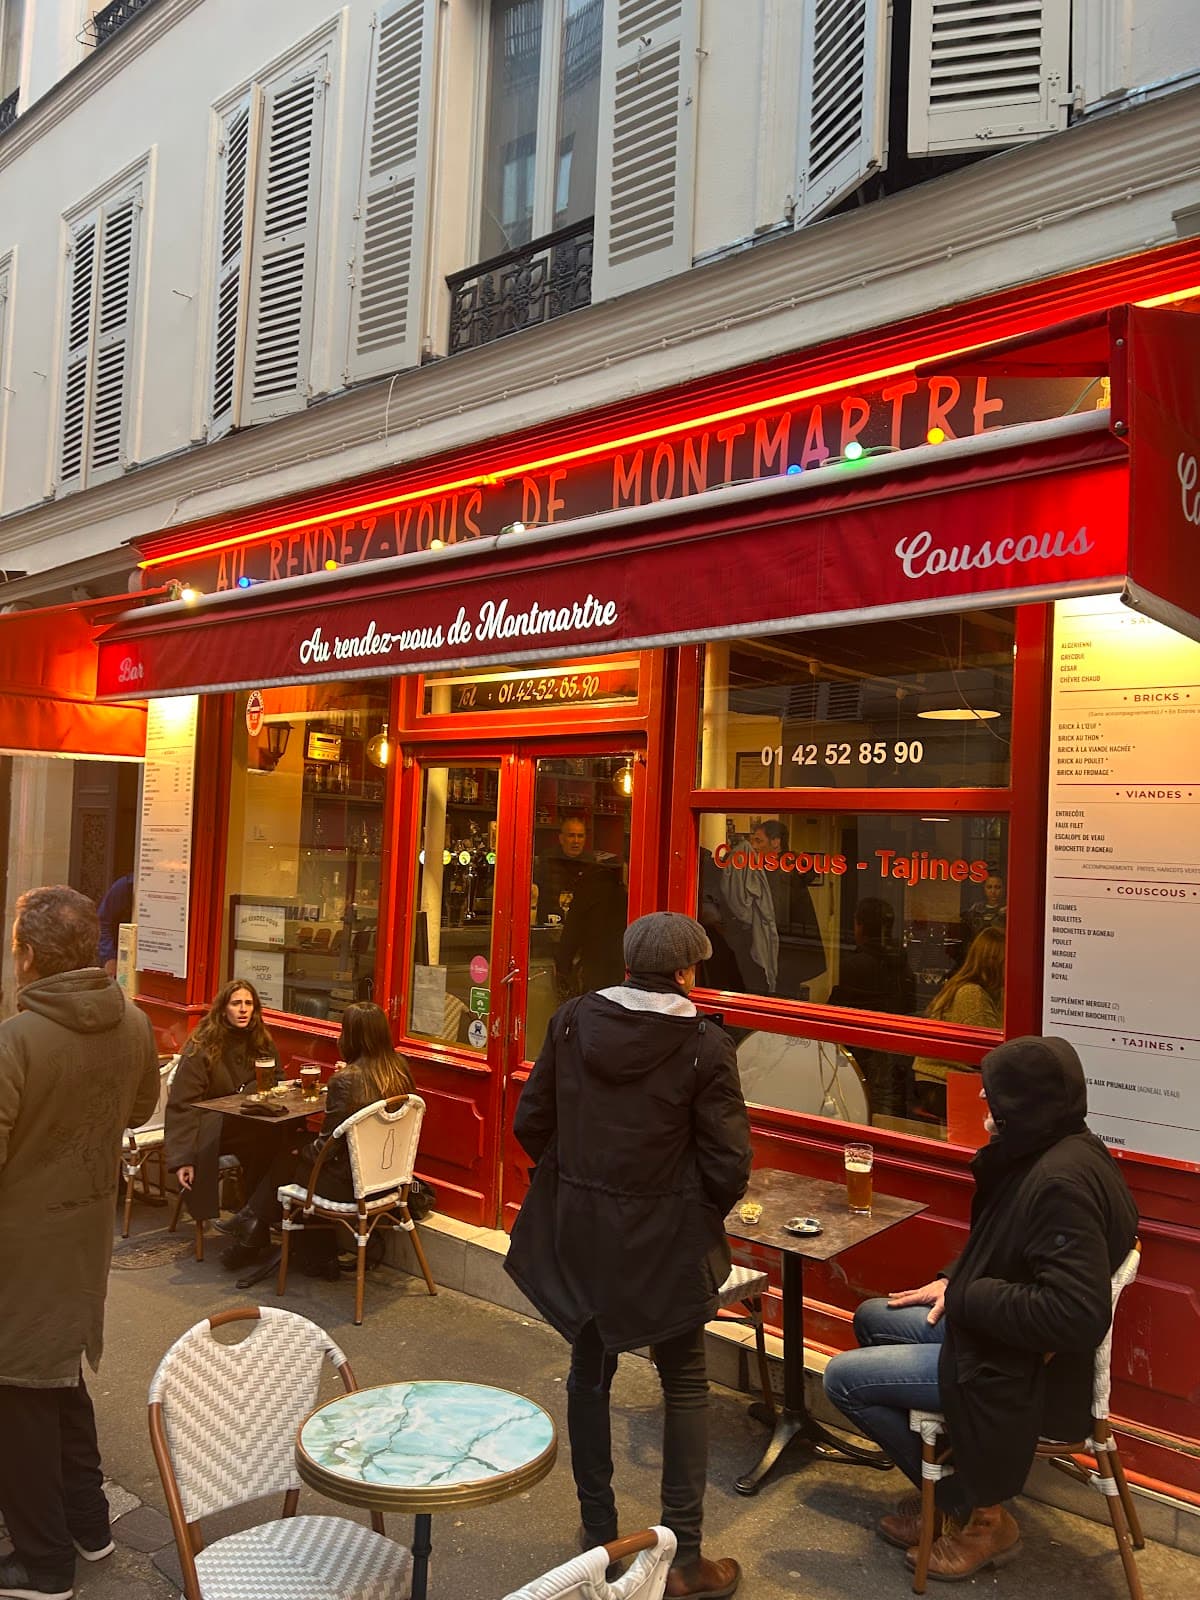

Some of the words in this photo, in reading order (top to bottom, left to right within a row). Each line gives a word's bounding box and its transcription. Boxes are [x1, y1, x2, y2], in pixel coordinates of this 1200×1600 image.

[216, 547, 248, 592] AU
[269, 491, 483, 582] RENDEZ-VOUS
[521, 469, 567, 529] DE
[611, 375, 1004, 509] MONTMARTRE
[895, 526, 1095, 579] Couscous
[300, 628, 332, 664] Au
[333, 620, 444, 661] rendez-vous
[447, 606, 472, 645] de
[475, 593, 618, 641] Montmartre
[118, 657, 144, 682] Bar
[1134, 692, 1180, 702] BRICKS
[760, 746, 784, 767] 01
[791, 744, 818, 766] 42
[824, 743, 851, 765] 52
[858, 742, 887, 765] 85
[893, 741, 924, 764] 90
[1125, 790, 1182, 799] VIANDES
[714, 844, 848, 876] Couscous
[875, 850, 990, 887] Tajines
[1116, 886, 1187, 898] COUSCOUS
[1052, 915, 1082, 923] BOULETTES
[1052, 926, 1086, 935] BROCHETTES
[1051, 949, 1077, 958] MERGUEZ
[1051, 961, 1072, 969] AGNEAU
[1051, 972, 1068, 981] ROYAL
[1085, 1000, 1111, 1008] MERGUEZ
[1085, 1011, 1116, 1021] BROCHETTE
[1121, 1037, 1174, 1051] TAJINES
[1093, 1079, 1105, 1087] AUX
[1106, 1080, 1136, 1091] PRUNEAUX
